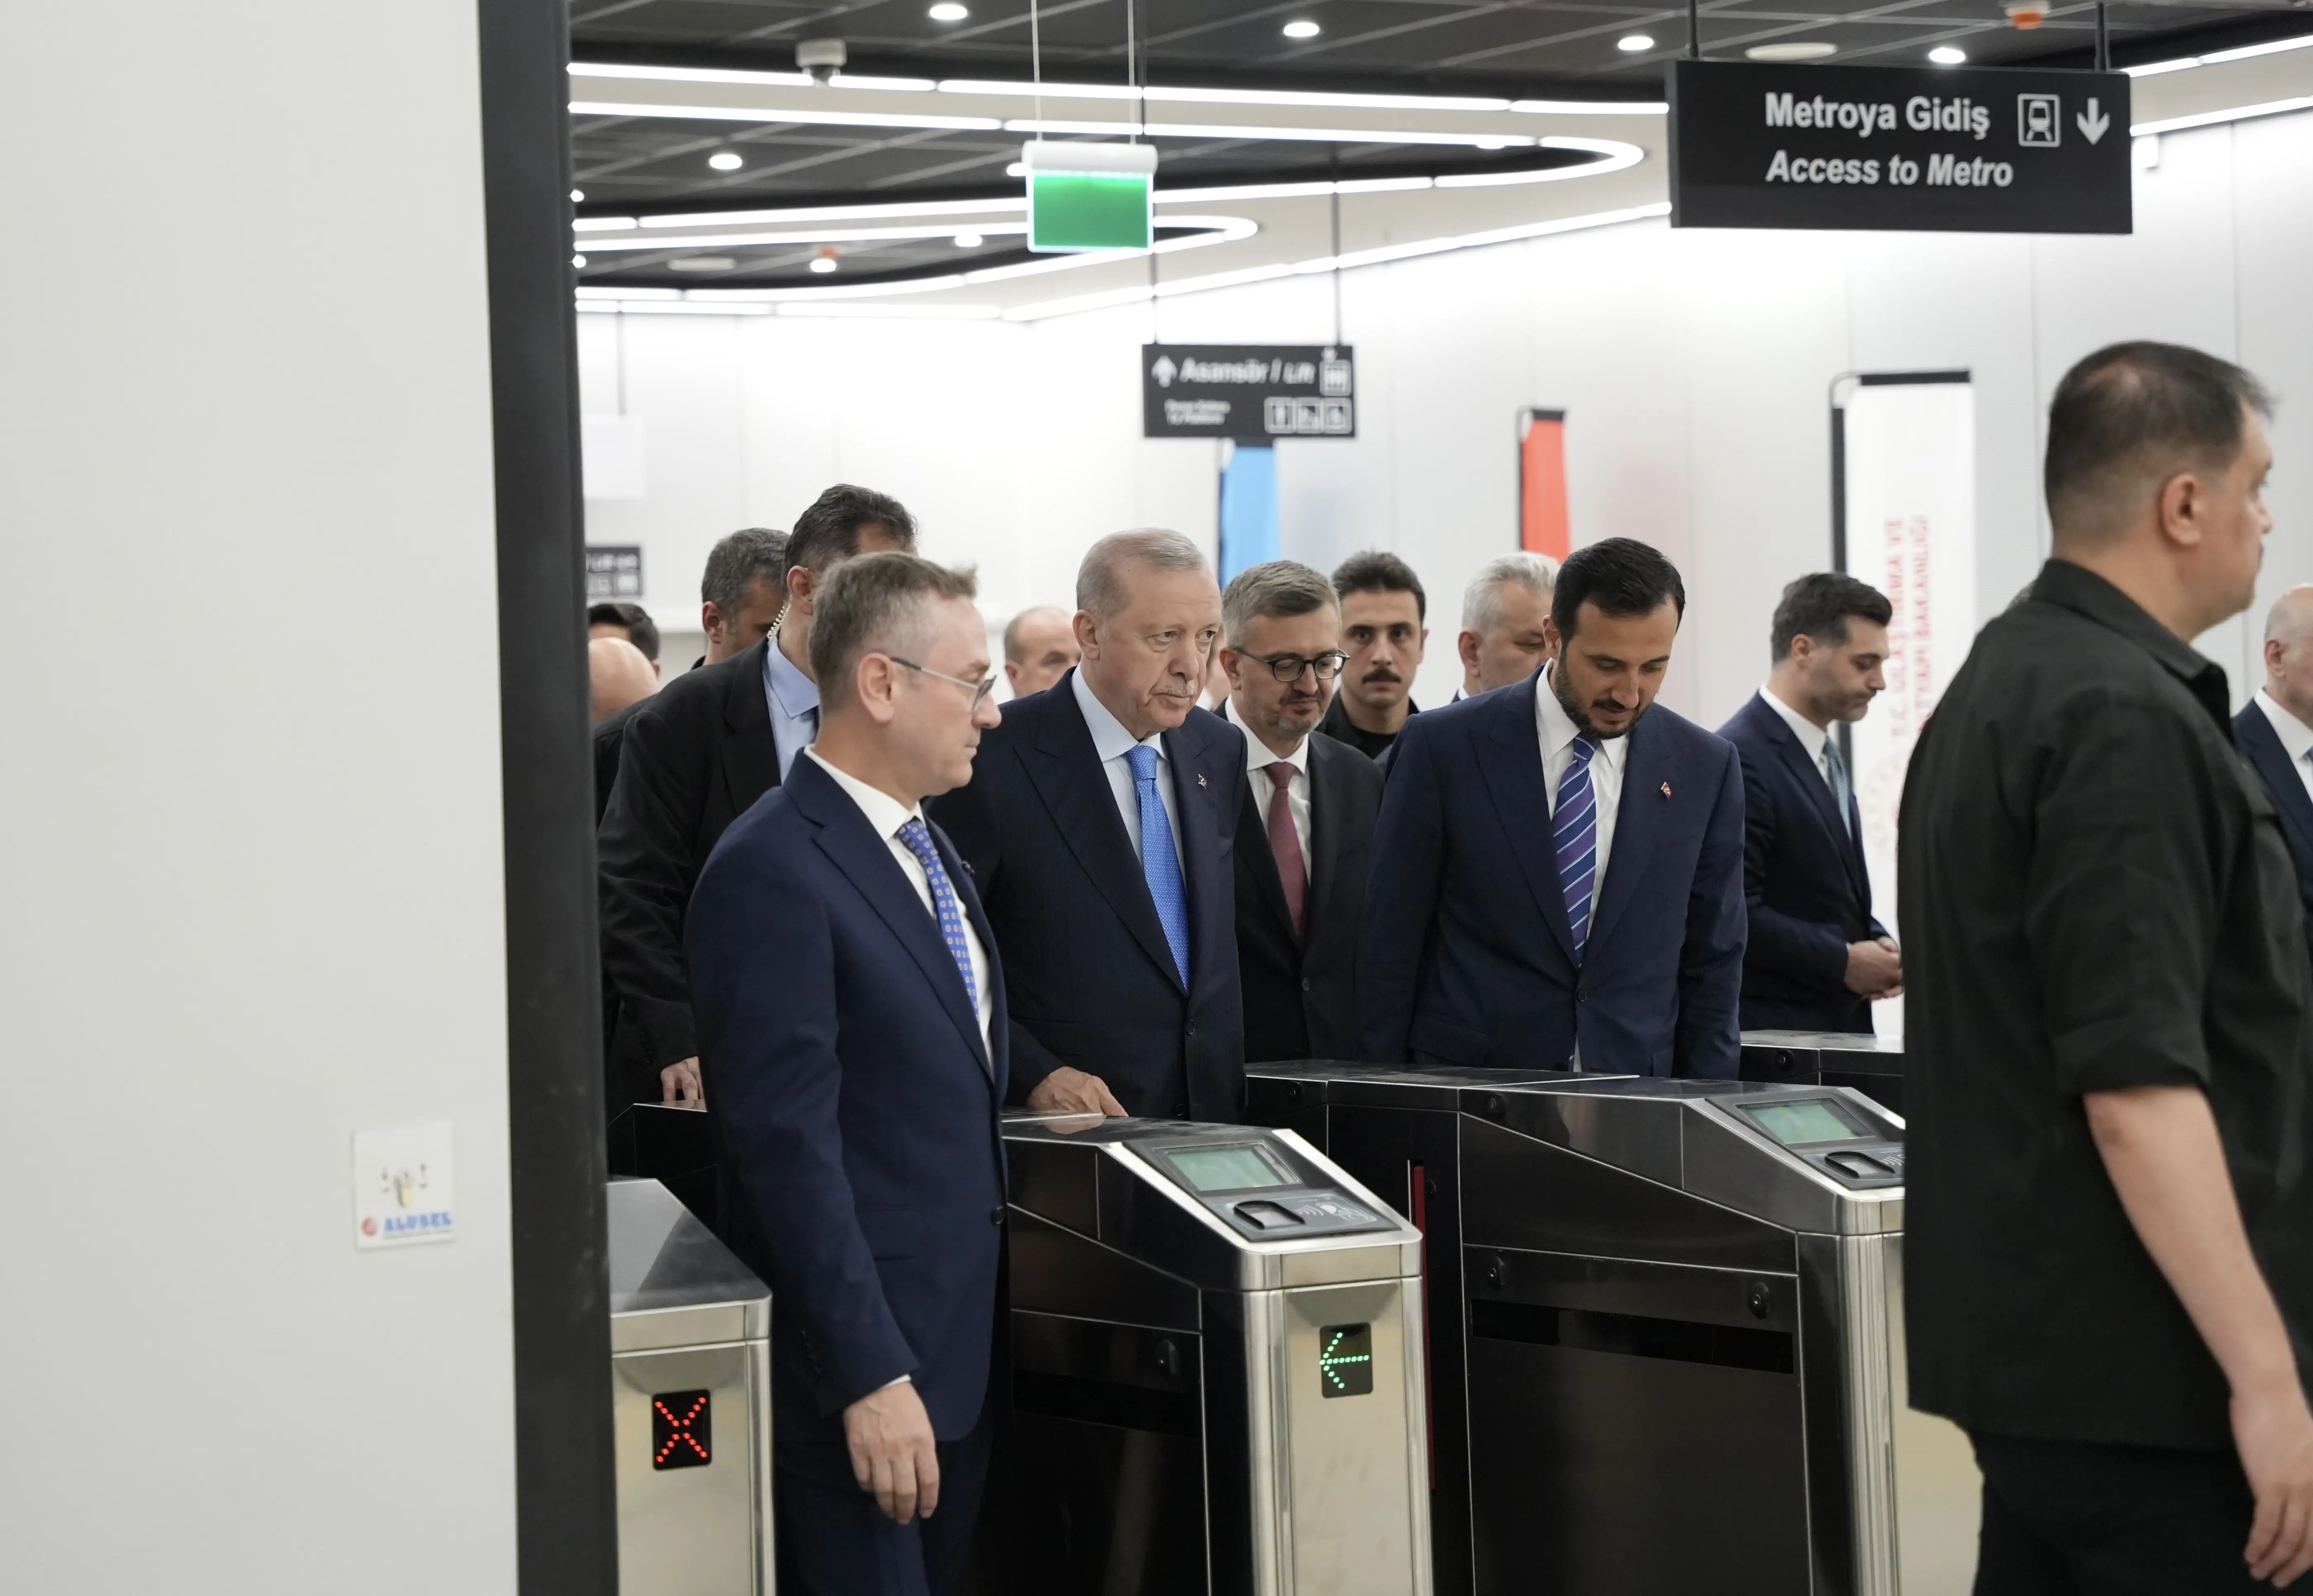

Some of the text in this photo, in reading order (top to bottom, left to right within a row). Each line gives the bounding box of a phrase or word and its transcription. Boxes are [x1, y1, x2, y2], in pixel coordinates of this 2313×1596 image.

[1765, 92, 1991, 140] Metroya Gidiş
[1765, 149, 2014, 187] Access to Metro
